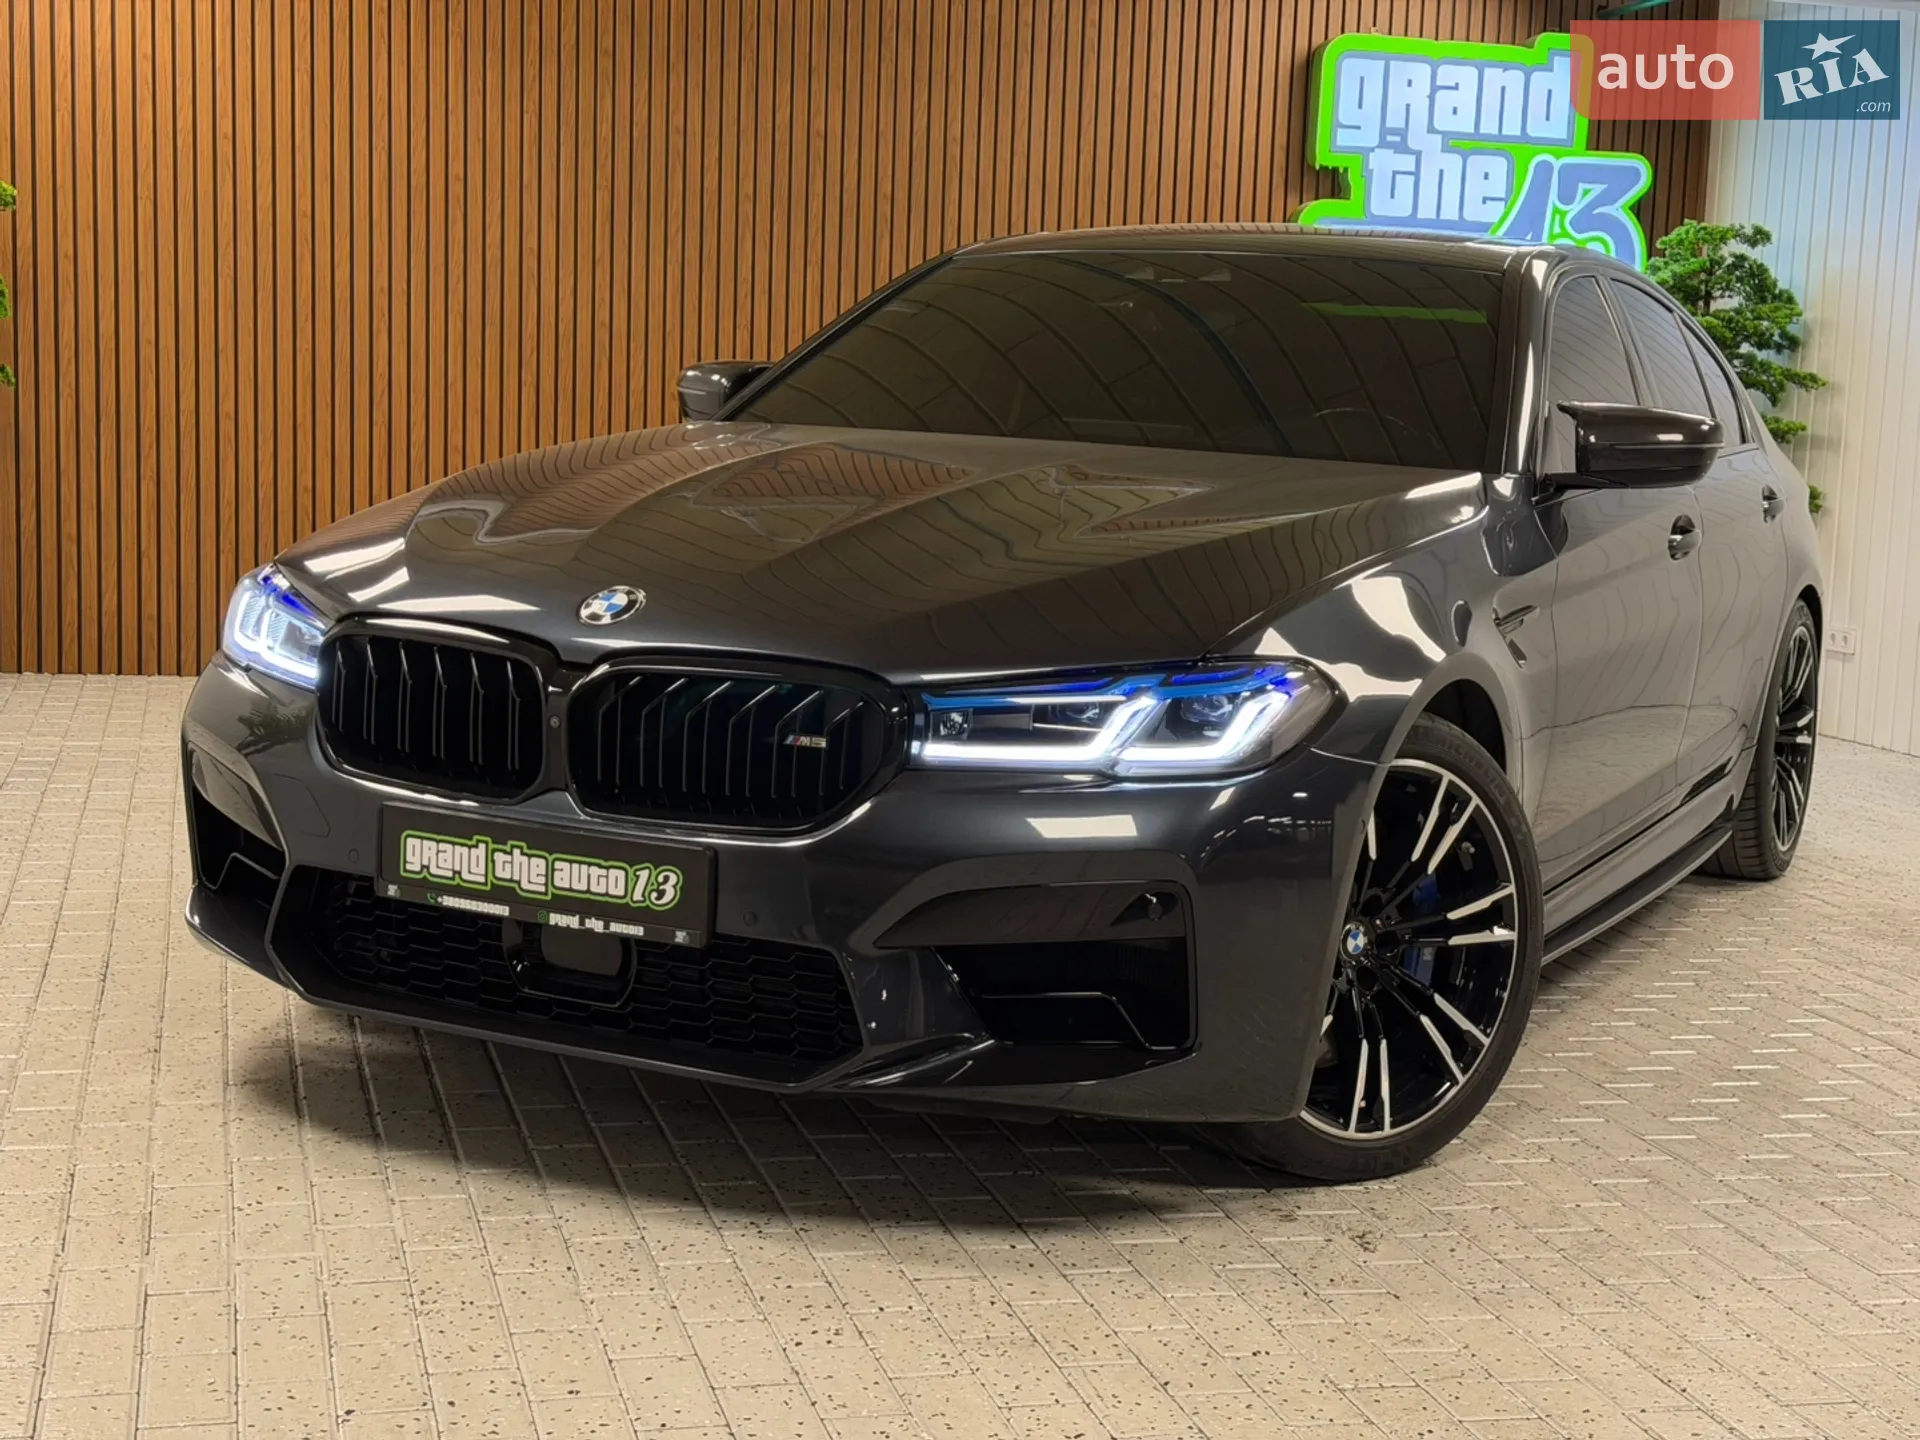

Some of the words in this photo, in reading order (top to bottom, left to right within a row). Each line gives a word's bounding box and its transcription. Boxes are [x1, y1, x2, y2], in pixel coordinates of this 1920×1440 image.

[1368, 136, 1509, 222] the
[1496, 155, 1646, 270] 13
[494, 848, 548, 893] the
